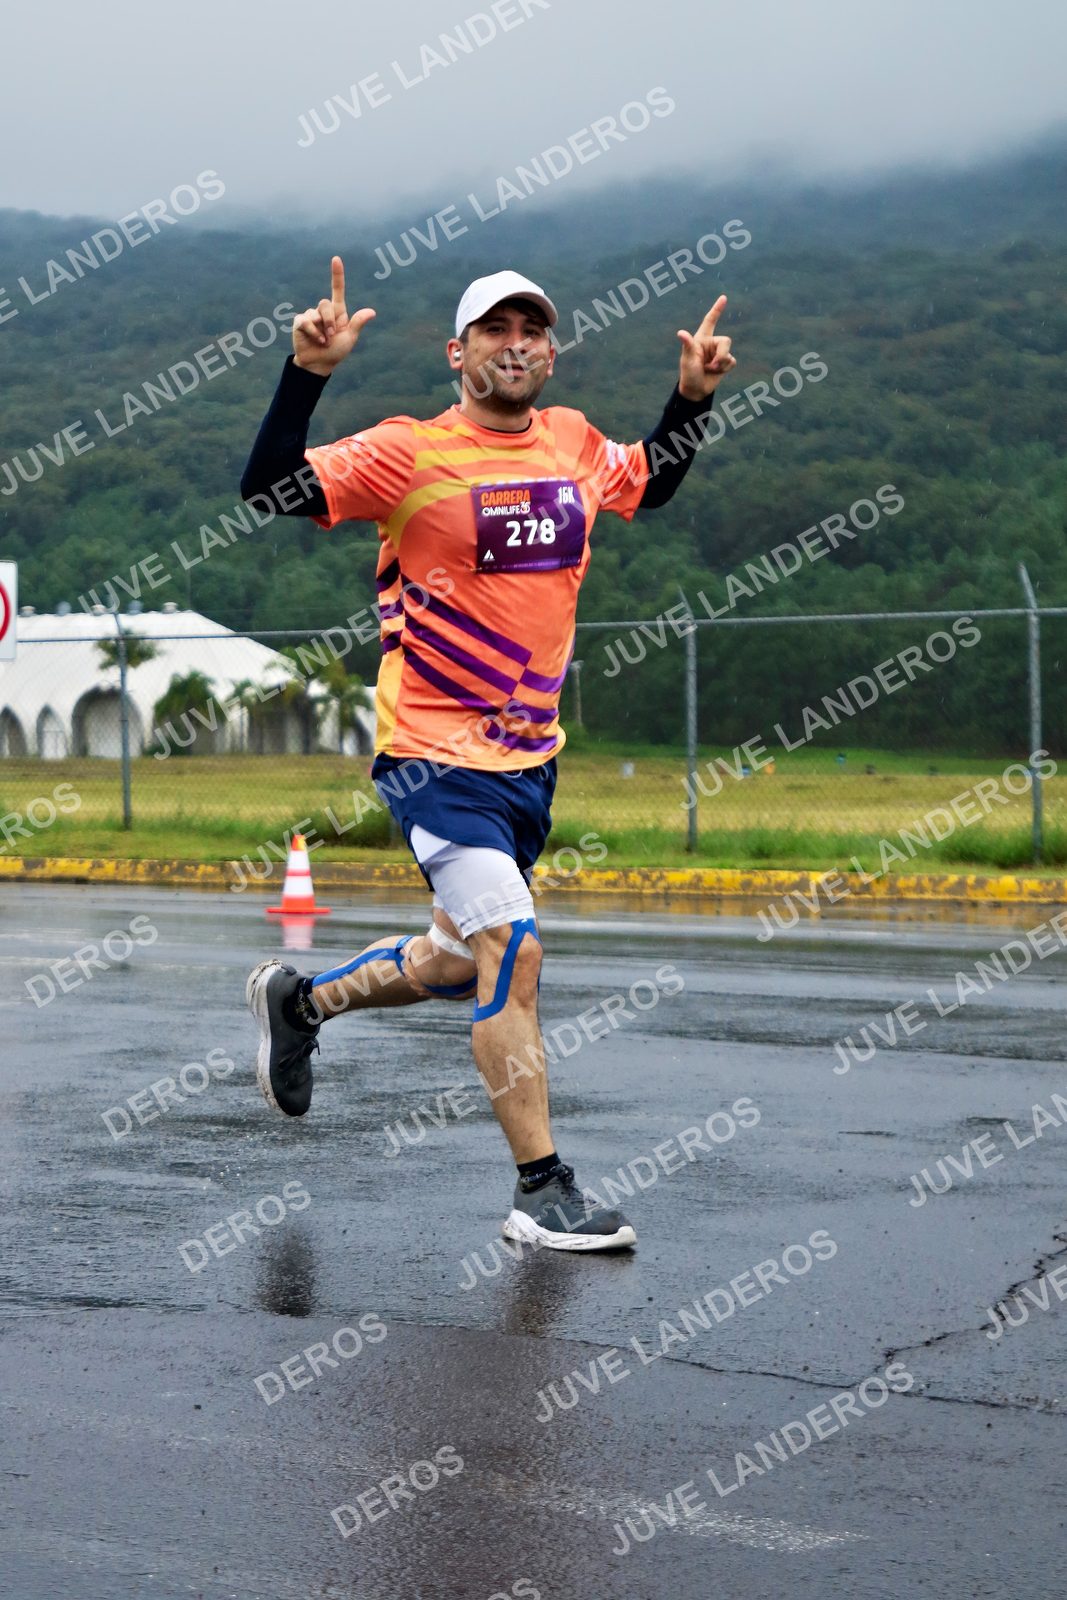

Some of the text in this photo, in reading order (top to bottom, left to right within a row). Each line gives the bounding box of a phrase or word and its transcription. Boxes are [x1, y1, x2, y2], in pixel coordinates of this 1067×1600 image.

[480, 489, 531, 506] CARRERA
[482, 504, 520, 517] OMNILIFE
[506, 518, 556, 547] 278
